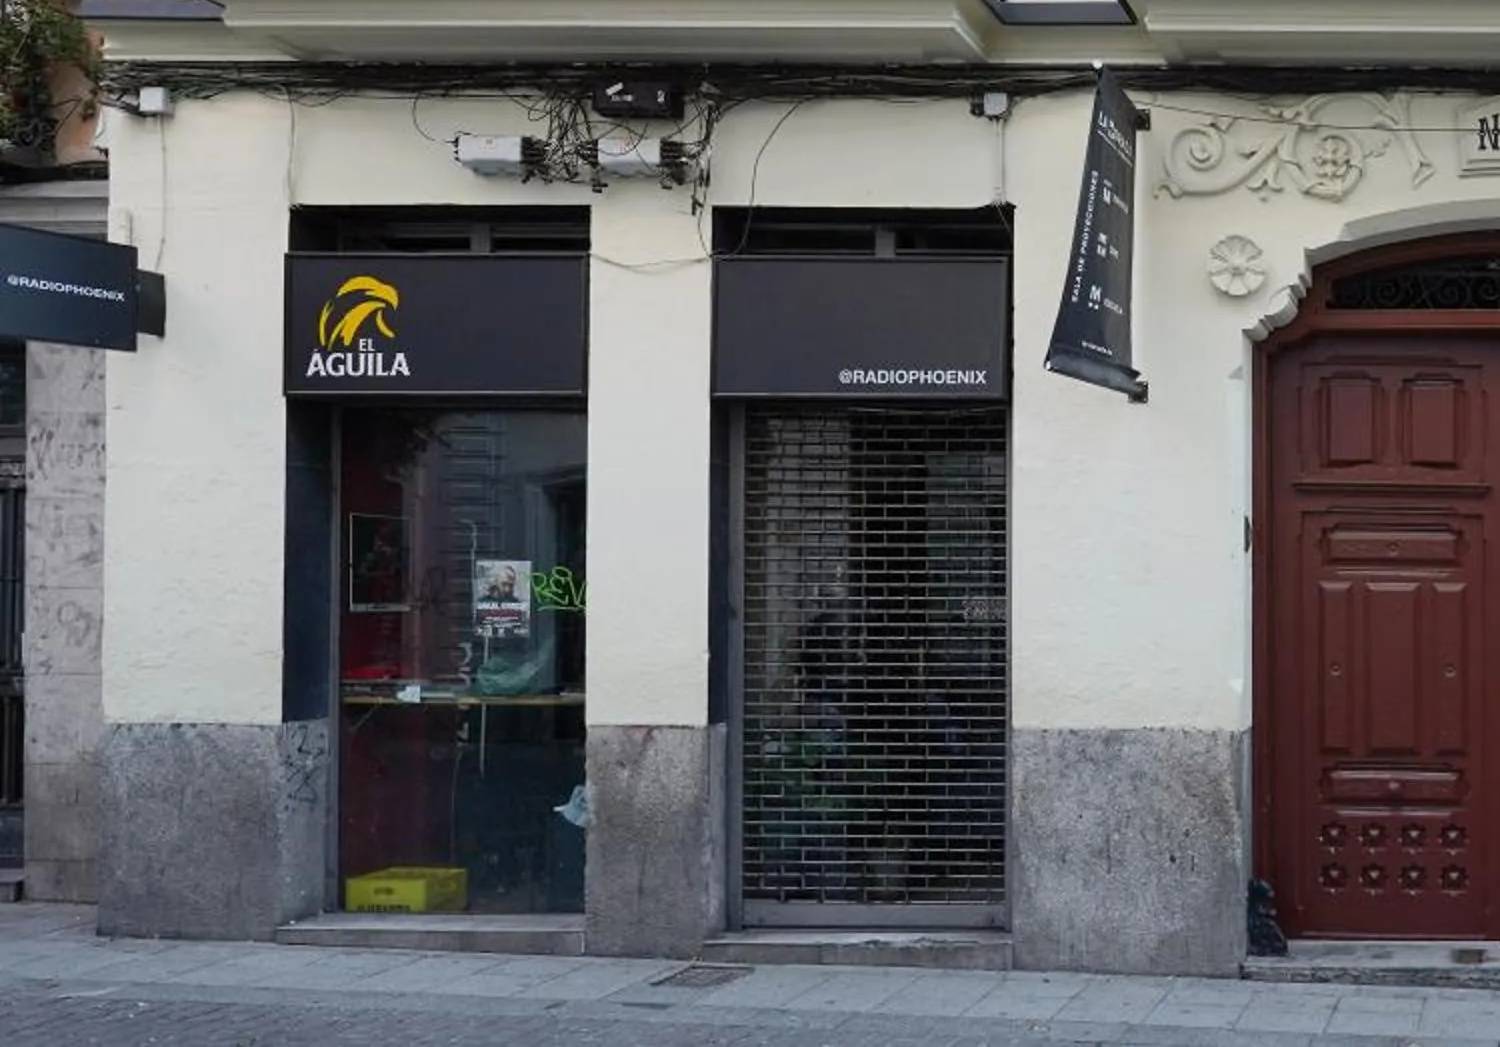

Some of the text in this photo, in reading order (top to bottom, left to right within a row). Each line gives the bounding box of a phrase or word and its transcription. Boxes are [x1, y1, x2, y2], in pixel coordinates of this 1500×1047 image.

[7, 274, 125, 302] @RADIOPHOENIX
[359, 338, 375, 352] EL
[306, 348, 411, 377] ÁGUILA
[839, 369, 987, 385] @RADIOPHOENIX
